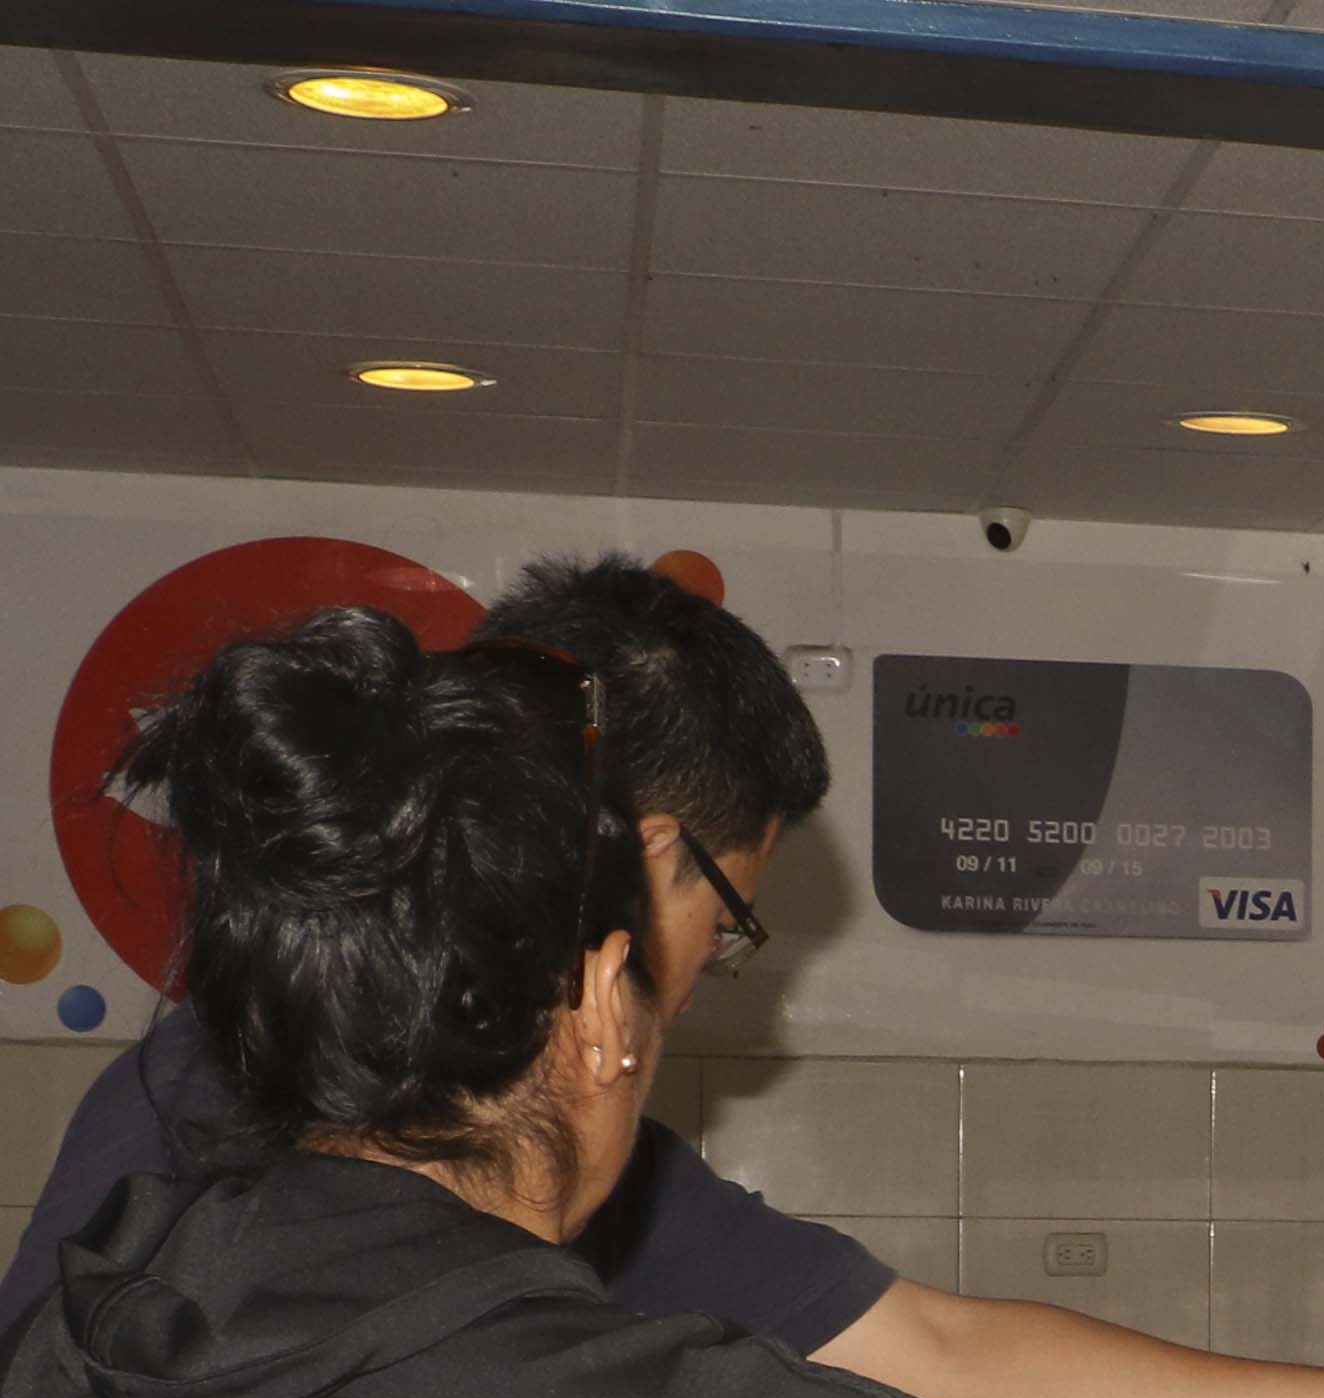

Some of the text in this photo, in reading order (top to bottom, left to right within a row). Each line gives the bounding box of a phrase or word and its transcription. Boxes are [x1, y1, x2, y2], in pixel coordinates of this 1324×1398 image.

[904, 684, 1018, 723] única
[939, 816, 1273, 851] 4220 5200 0027 2003
[940, 894, 1009, 912] KARINA
[1206, 887, 1299, 923] VISA
